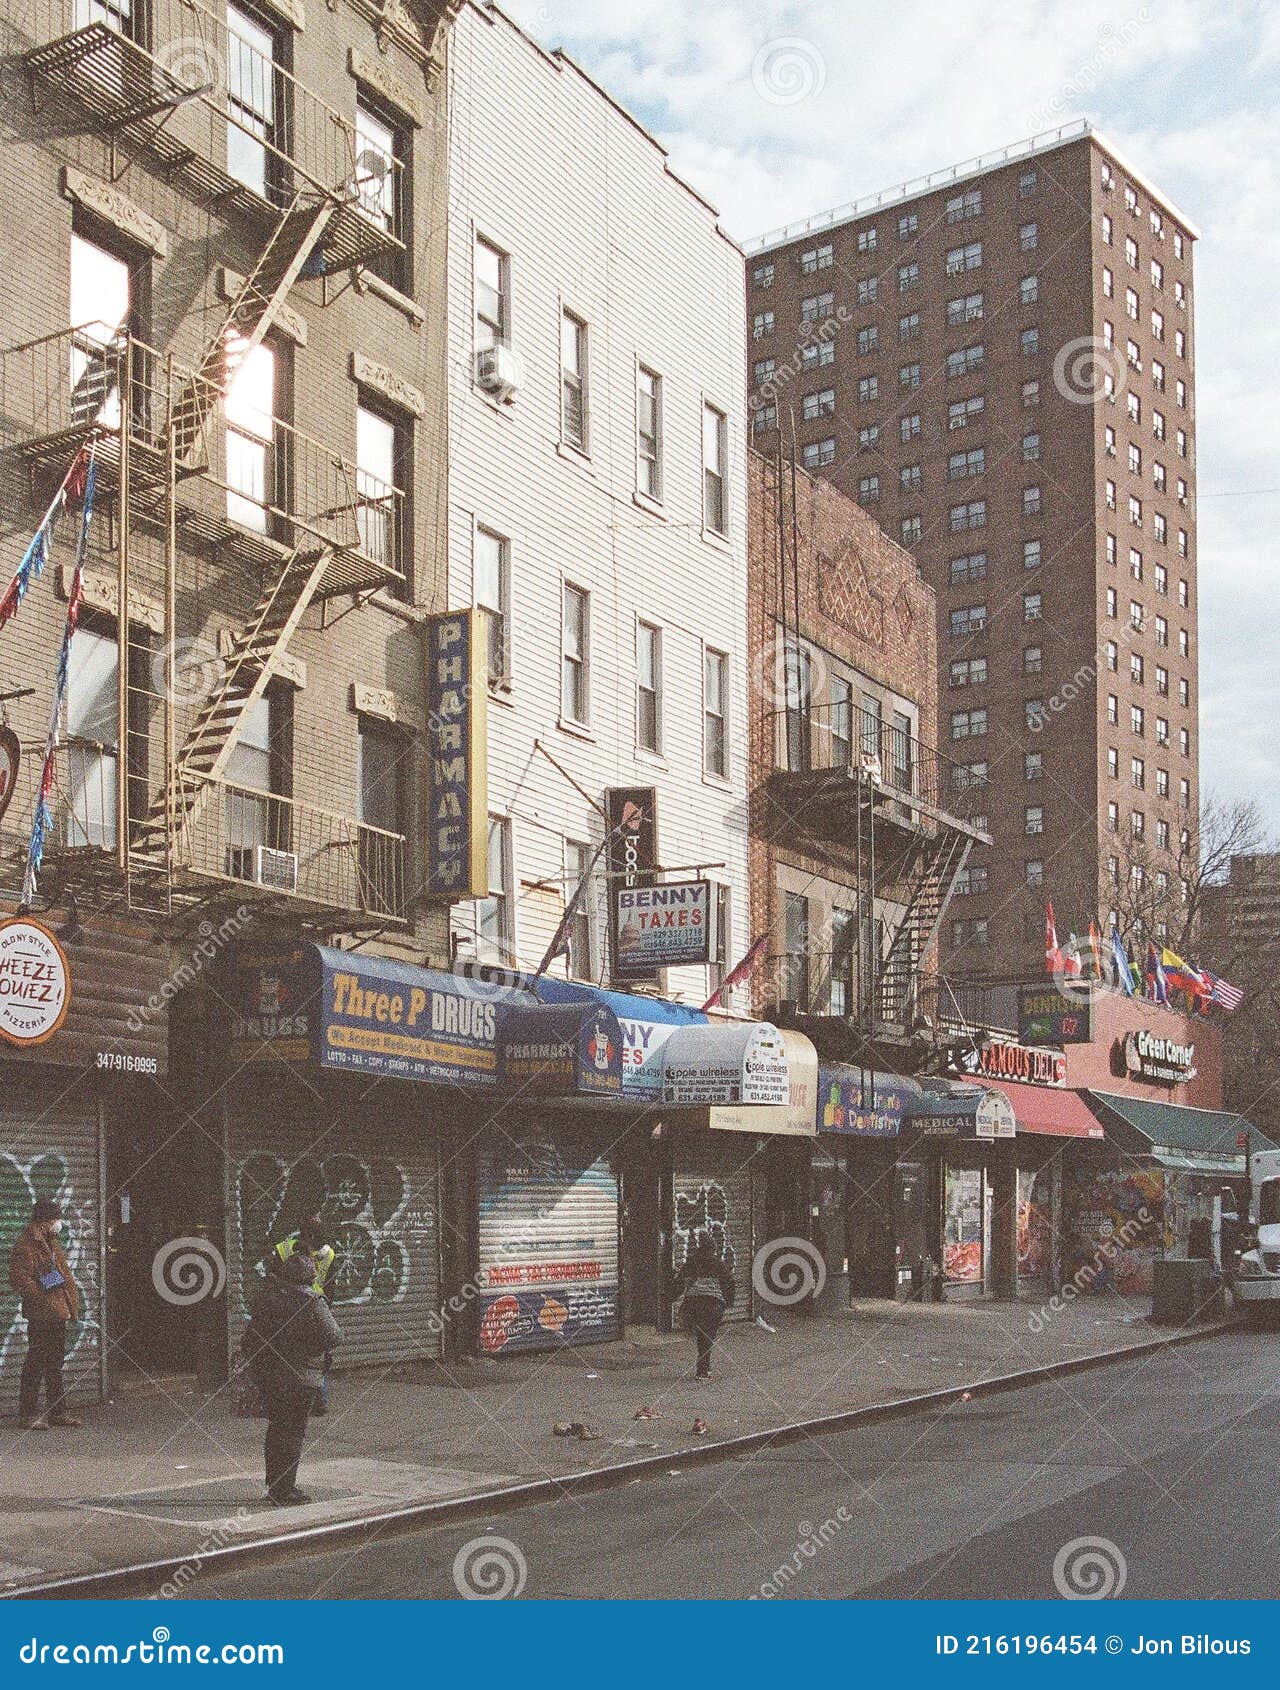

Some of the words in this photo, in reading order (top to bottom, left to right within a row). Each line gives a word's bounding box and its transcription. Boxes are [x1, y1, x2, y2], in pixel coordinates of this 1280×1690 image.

[434, 622, 465, 886] PHARMACY
[620, 886, 705, 909] BENNY
[638, 909, 703, 929] TAXES
[1, 935, 17, 950] OLD
[28, 935, 52, 957] STYLE
[0, 958, 58, 982] HEEZE
[0, 978, 62, 1005] OUIEZ!
[333, 971, 403, 1024] Three
[407, 987, 427, 1027] P
[431, 991, 497, 1041] DRUGS
[3, 1009, 47, 1030] PIZZERIA
[327, 1050, 347, 1063] LOTTO
[352, 1054, 363, 1065] FAX
[368, 1056, 384, 1068] COPY
[505, 1043, 577, 1060] PHARMACY
[1138, 1030, 1165, 1060] Green
[1166, 1039, 1195, 1066] Corner
[97, 1053, 158, 1074] 347-916-0995
[700, 1066, 740, 1078] wireless
[766, 1062, 788, 1074] wireless
[981, 1042, 1030, 1078] FAMOUS
[1033, 1051, 1055, 1082] DELI
[849, 1109, 901, 1136] Dentistry
[911, 1117, 973, 1129] MEDICAL
